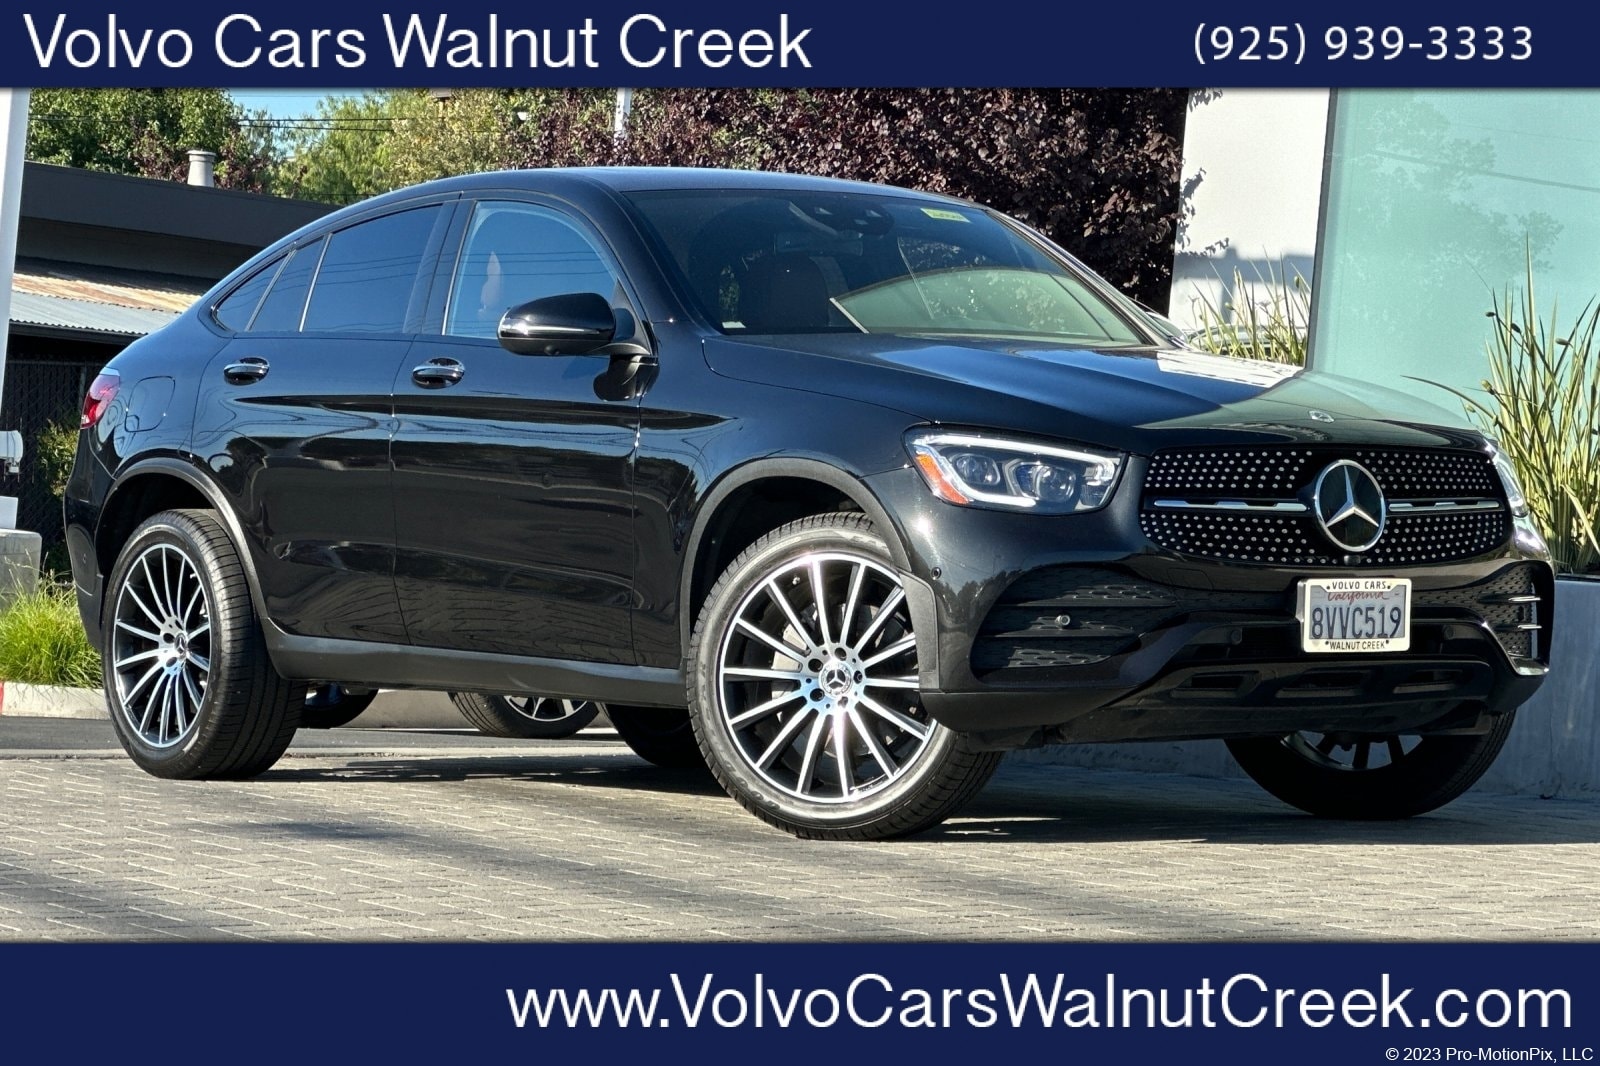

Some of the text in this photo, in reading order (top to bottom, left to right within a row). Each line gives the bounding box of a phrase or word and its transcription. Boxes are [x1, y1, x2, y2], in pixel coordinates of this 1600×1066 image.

[1332, 581, 1387, 590] VOLVO CARS
[1311, 606, 1402, 639] 8VVC519
[1329, 641, 1385, 650] WALNUT CREEK
